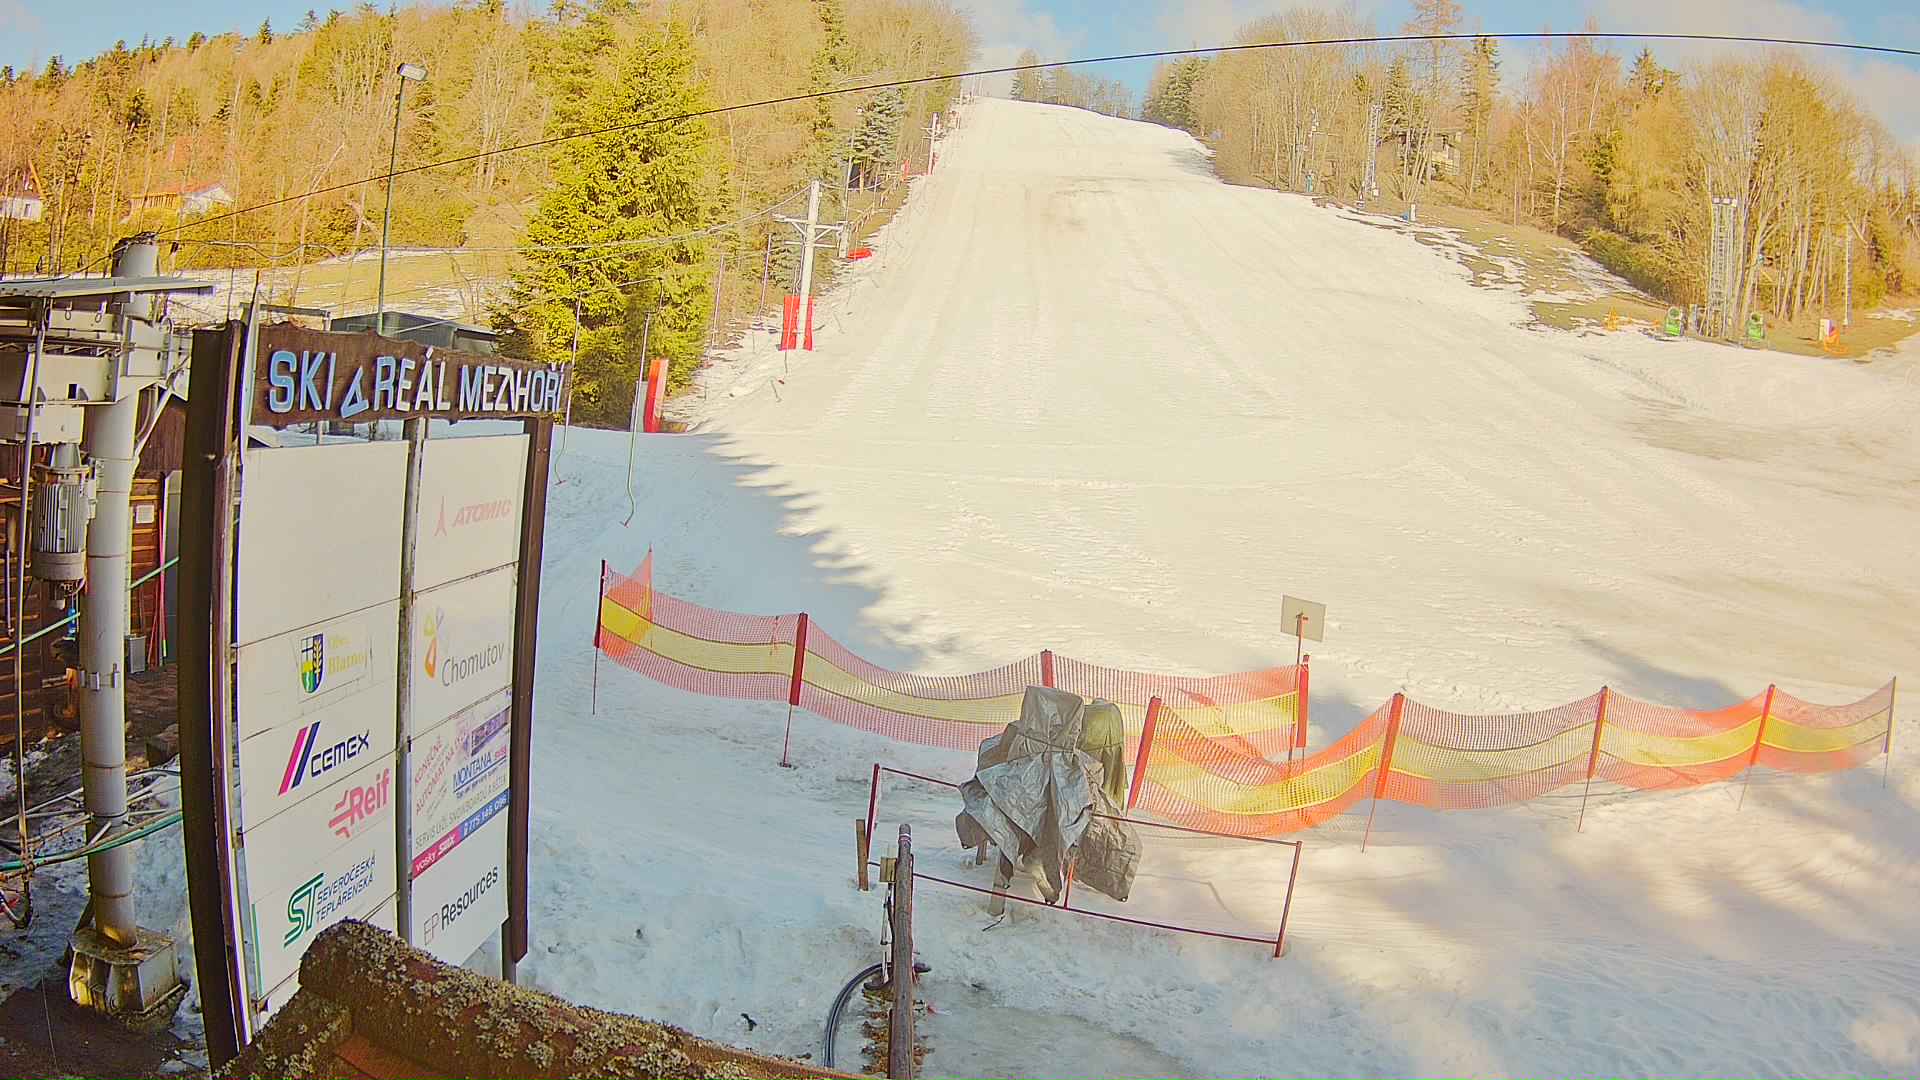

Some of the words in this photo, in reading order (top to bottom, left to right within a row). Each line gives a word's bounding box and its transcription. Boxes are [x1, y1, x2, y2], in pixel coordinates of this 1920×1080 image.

[269, 350, 336, 414] SKI
[452, 500, 512, 528] ATOMIC
[441, 642, 505, 687] Chomutov
[311, 729, 370, 778] CEMEX
[453, 752, 492, 790] MONTANA
[350, 768, 389, 826] Reif
[441, 866, 498, 930] Resources
